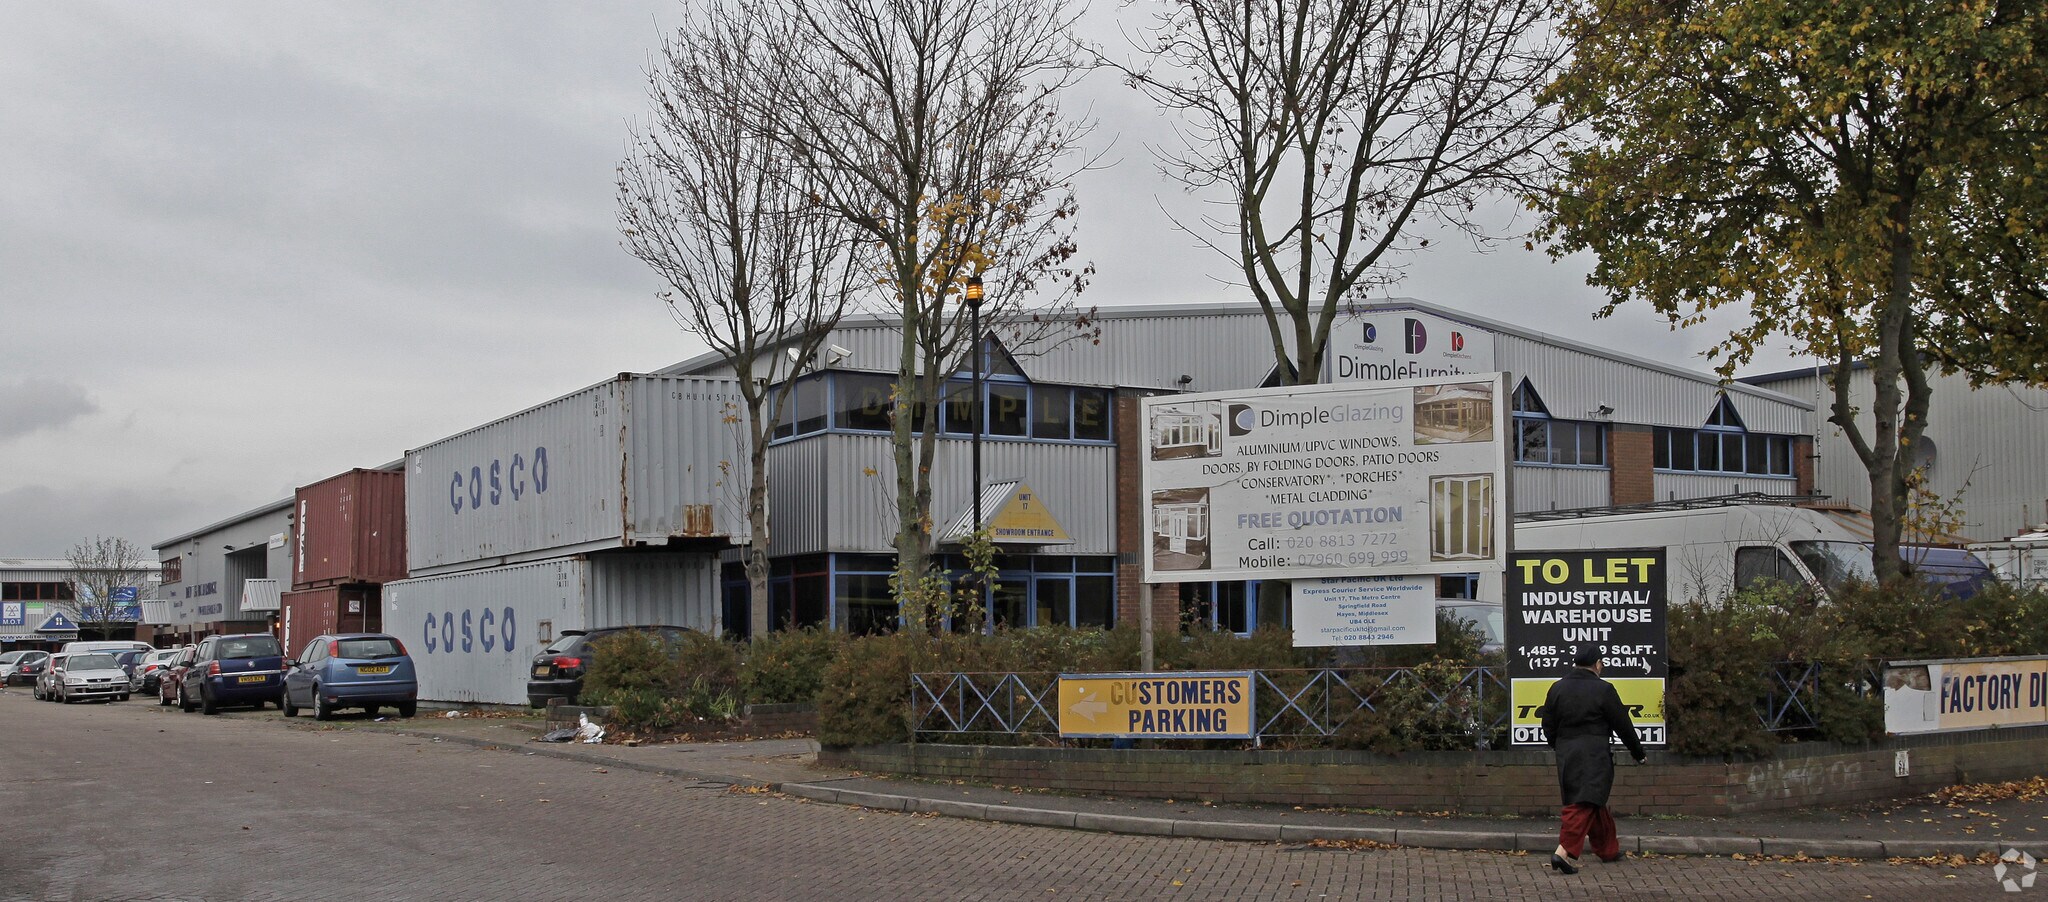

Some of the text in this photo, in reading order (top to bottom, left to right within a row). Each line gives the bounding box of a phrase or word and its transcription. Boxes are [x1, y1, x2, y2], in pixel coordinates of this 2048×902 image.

[1261, 402, 1403, 429] DimpleGlazing
[1236, 440, 1336, 456] ALUMINIUM/UPVC
[1247, 461, 1260, 472] BY
[1263, 458, 1312, 471] FOLDING
[1362, 453, 1395, 466] PATIO
[1398, 450, 1440, 464] DOORS
[450, 446, 549, 516] COSCO
[1237, 506, 1402, 530] FREE QUOTATION
[996, 528, 1054, 537] SHOWROOM ENTRANCE
[1248, 532, 1398, 550] Call: 020 8813 7272
[1239, 550, 1408, 568] Mobile: 07960 699 999
[1516, 558, 1656, 585] TO LET
[1522, 590, 1651, 606] INDUSTRIAL/
[1522, 608, 1652, 624] WAREHOUSE
[423, 606, 516, 655] COSCO
[1562, 627, 1612, 642] UNIT
[1518, 645, 1556, 658] 1,485
[1611, 645, 1657, 656] SQ.FT.
[1529, 657, 1559, 670] (137
[1110, 680, 1241, 706] CUSTOMERS
[1940, 674, 2022, 714] FACTORY
[1128, 708, 1227, 732] PARKING
